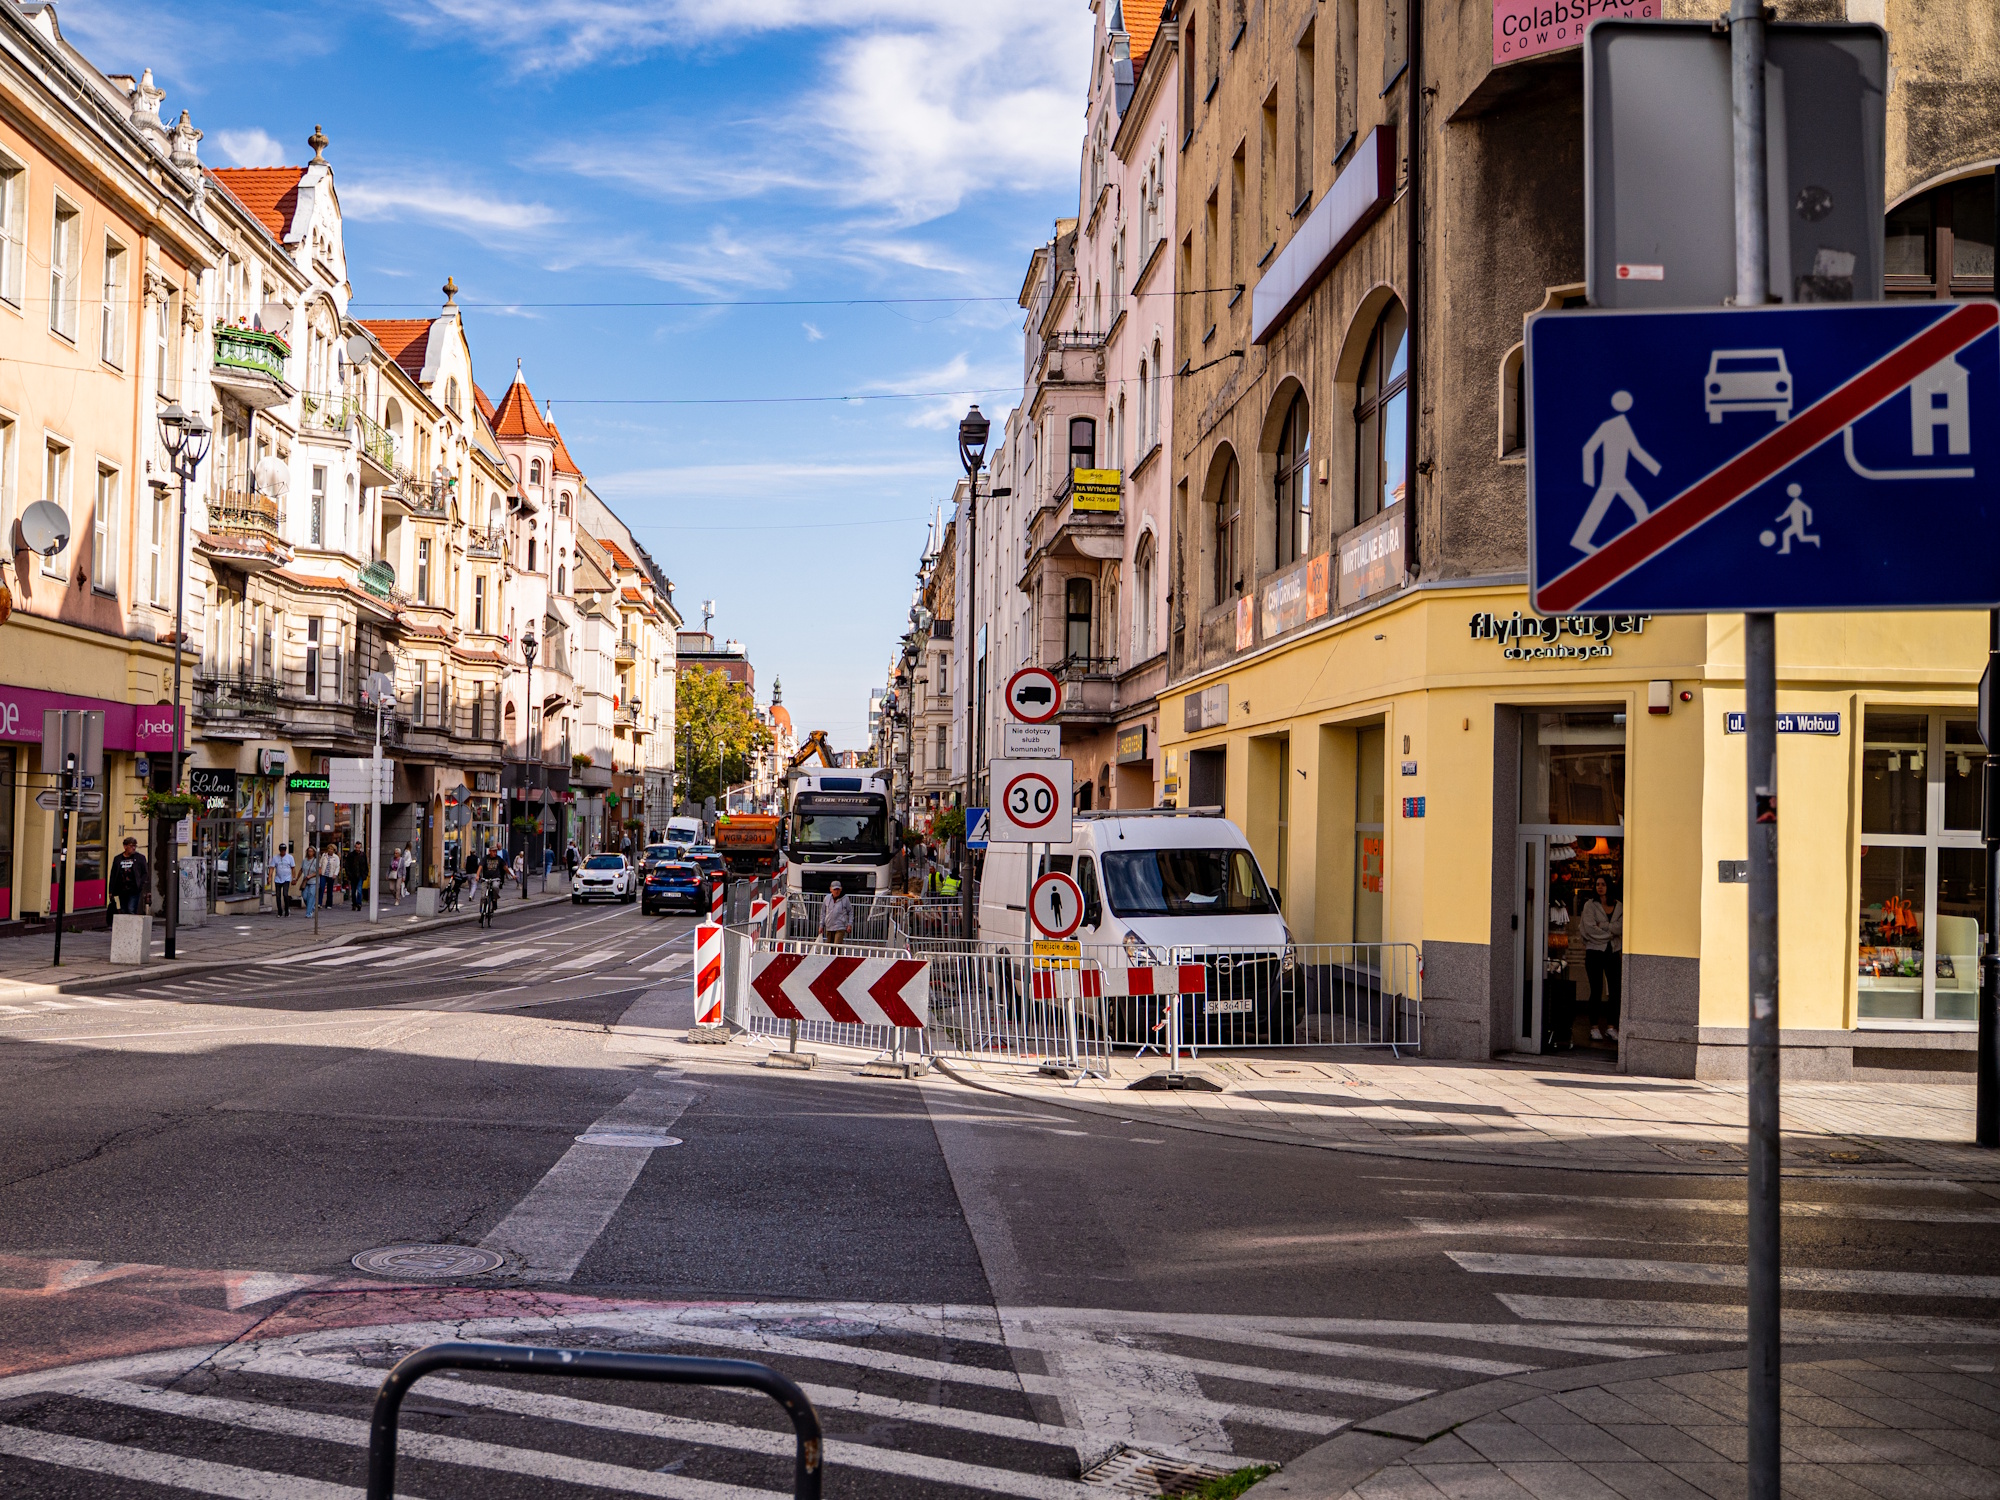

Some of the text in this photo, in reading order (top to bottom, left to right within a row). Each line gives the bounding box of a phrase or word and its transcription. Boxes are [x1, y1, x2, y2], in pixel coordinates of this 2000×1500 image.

[1087, 485, 1118, 494] WYNAJEM
[1342, 526, 1400, 576] WIRTUALNE BIURA
[1268, 578, 1301, 611] COWORKING
[1469, 611, 1560, 645] flying
[1503, 644, 1613, 662] copenhagen
[1024, 728, 1051, 736] dotyczy
[1730, 715, 1745, 731] ul.
[1796, 715, 1836, 732] Wałów
[192, 771, 234, 793] Lilou
[290, 779, 330, 789] SPRZED
[1012, 787, 1052, 814] 30
[1035, 942, 1061, 951] Przejście
